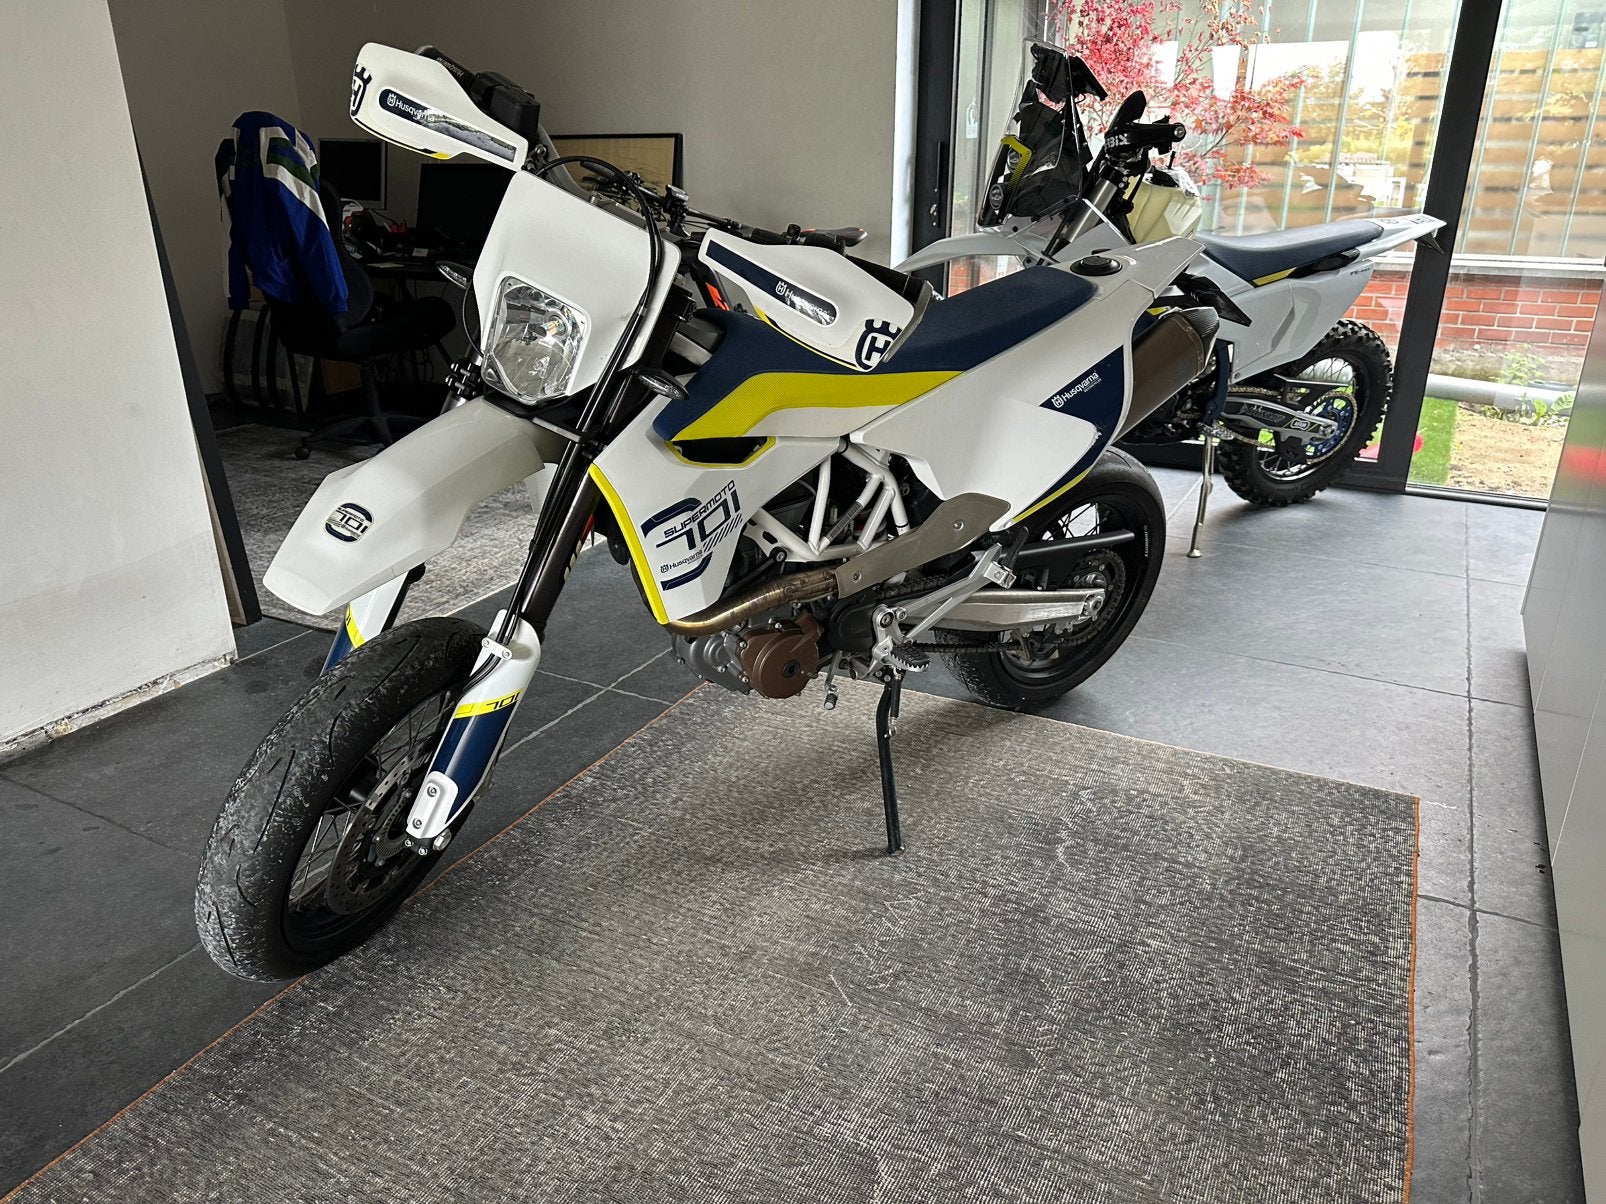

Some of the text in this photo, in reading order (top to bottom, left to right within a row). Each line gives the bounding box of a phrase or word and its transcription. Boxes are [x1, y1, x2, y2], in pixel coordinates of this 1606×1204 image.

[1062, 372, 1099, 401] Husqvarna
[335, 510, 368, 533] 701
[656, 489, 740, 550] 701
[664, 480, 736, 538] SUPERMOTO
[669, 550, 703, 570] Husqvarna
[487, 692, 520, 709] 701
